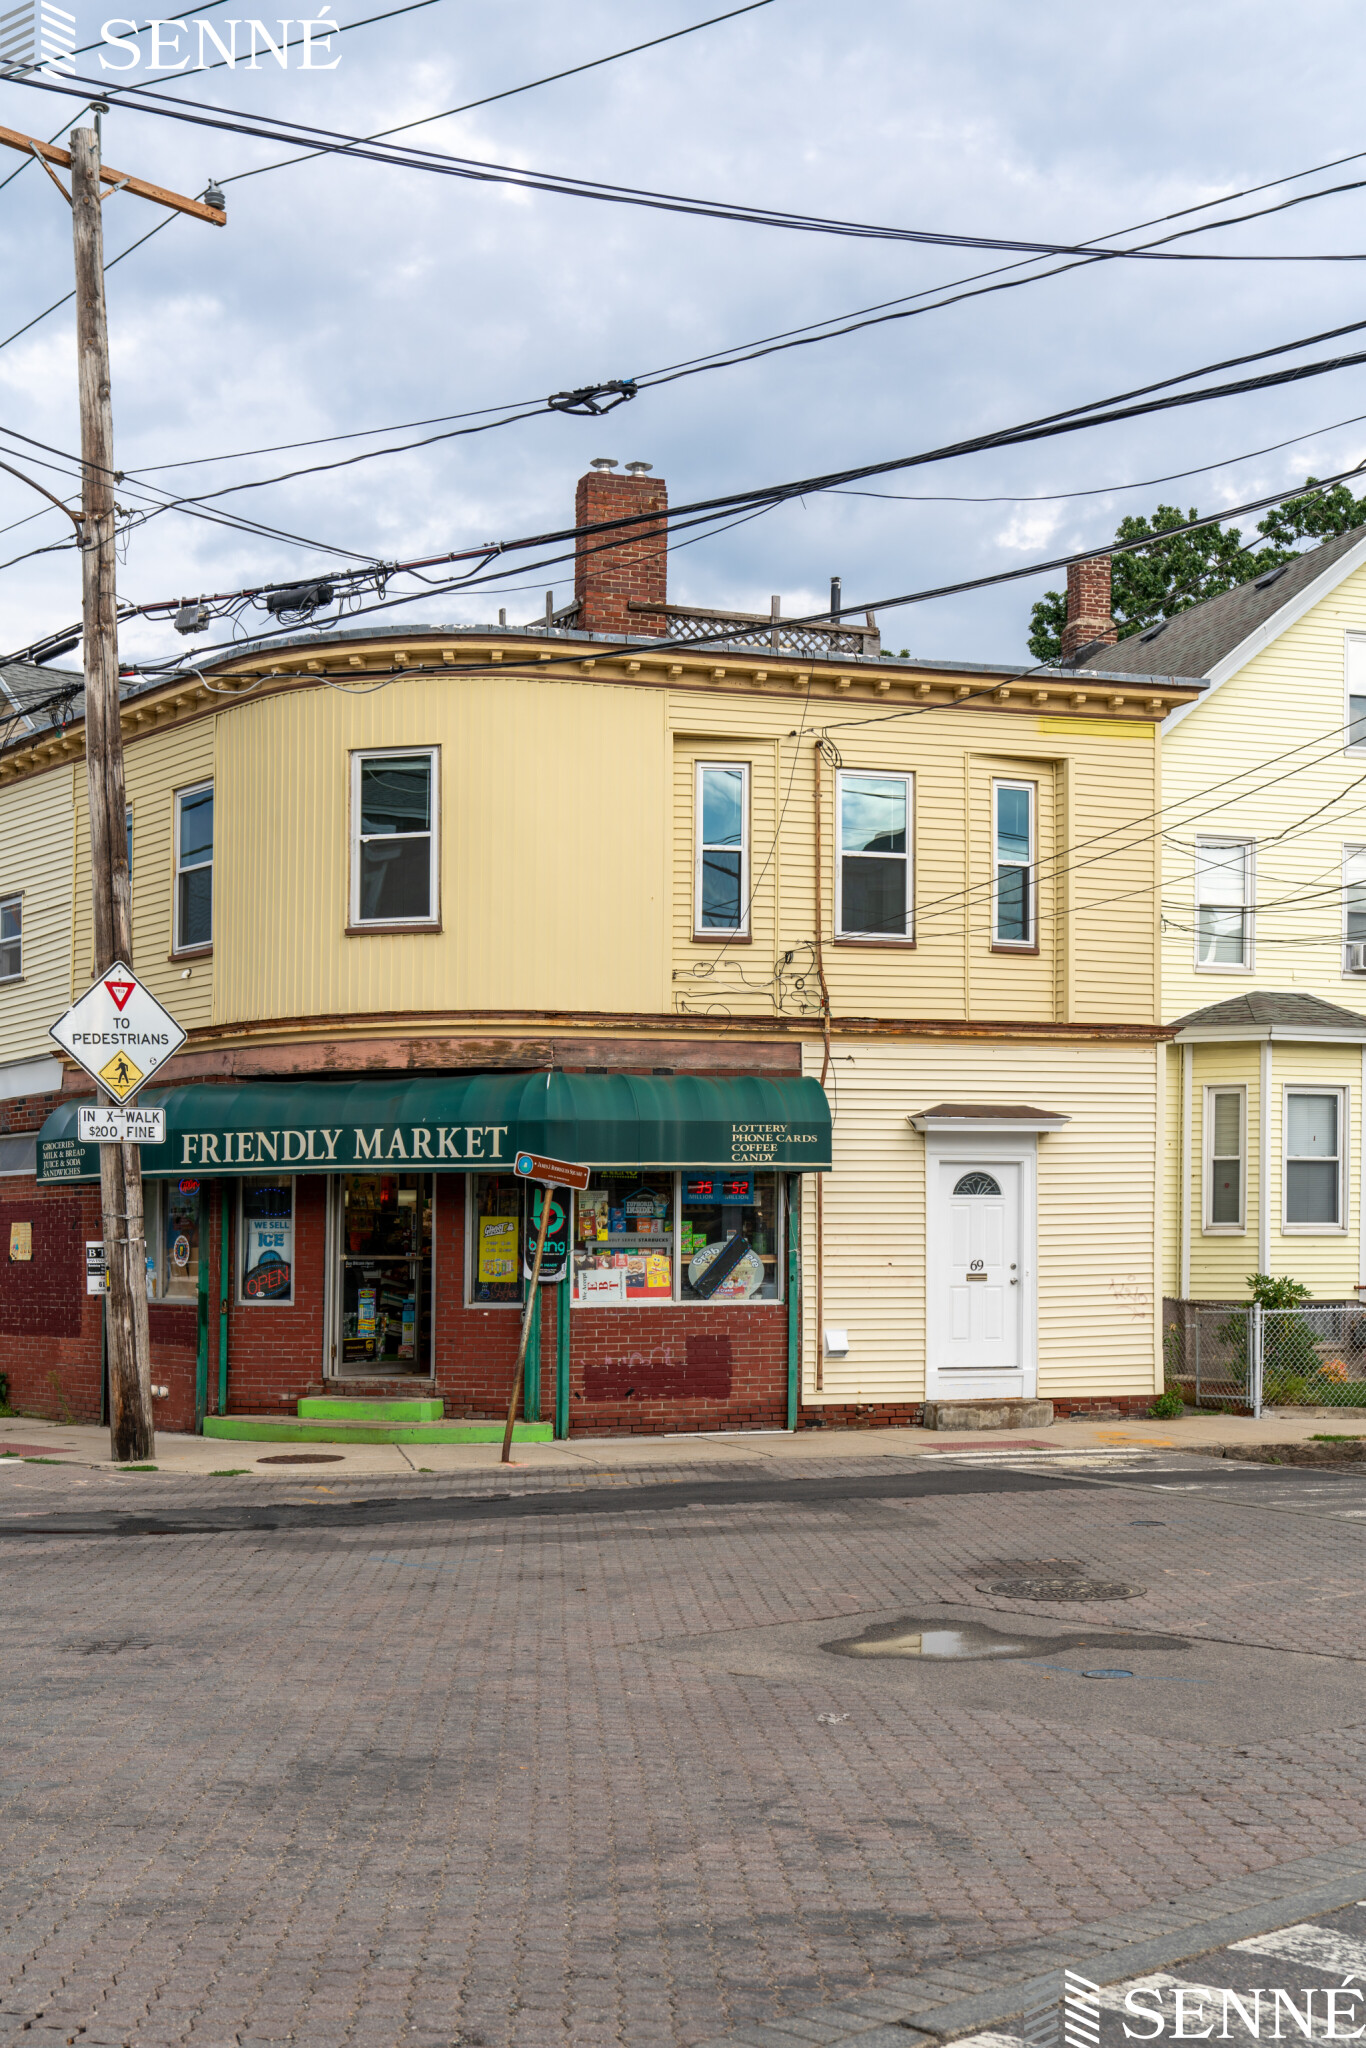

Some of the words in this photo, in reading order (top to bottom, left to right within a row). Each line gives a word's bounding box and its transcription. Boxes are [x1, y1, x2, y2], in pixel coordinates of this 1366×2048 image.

[113, 1018, 130, 1029] TO
[72, 1033, 169, 1045] PEDESTRIANS
[83, 1110, 95, 1122] IN
[89, 1126, 118, 1137] $200
[126, 1127, 156, 1138] FINE
[731, 1124, 788, 1133] LOTTERY
[731, 1133, 774, 1142] PHONE
[775, 1133, 818, 1143] CARDS
[42, 1140, 75, 1151] GROCERIES
[180, 1129, 343, 1164] FRIENDLY
[353, 1125, 508, 1160] MARKET
[731, 1143, 779, 1152] COFFEE
[42, 1151, 58, 1160] MILK
[65, 1149, 86, 1158] BREAD
[731, 1153, 775, 1162] CANDY
[43, 1160, 60, 1171] JUICE
[66, 1158, 81, 1167] SODA
[42, 1167, 81, 1178] SANDWICHES
[696, 1181, 713, 1194] 35
[732, 1181, 749, 1194] 52
[254, 1221, 268, 1229] WE
[269, 1221, 290, 1229] SELL
[257, 1232, 285, 1248] ICE
[969, 1259, 984, 1271] 69
[246, 1265, 289, 1295] OPEN
